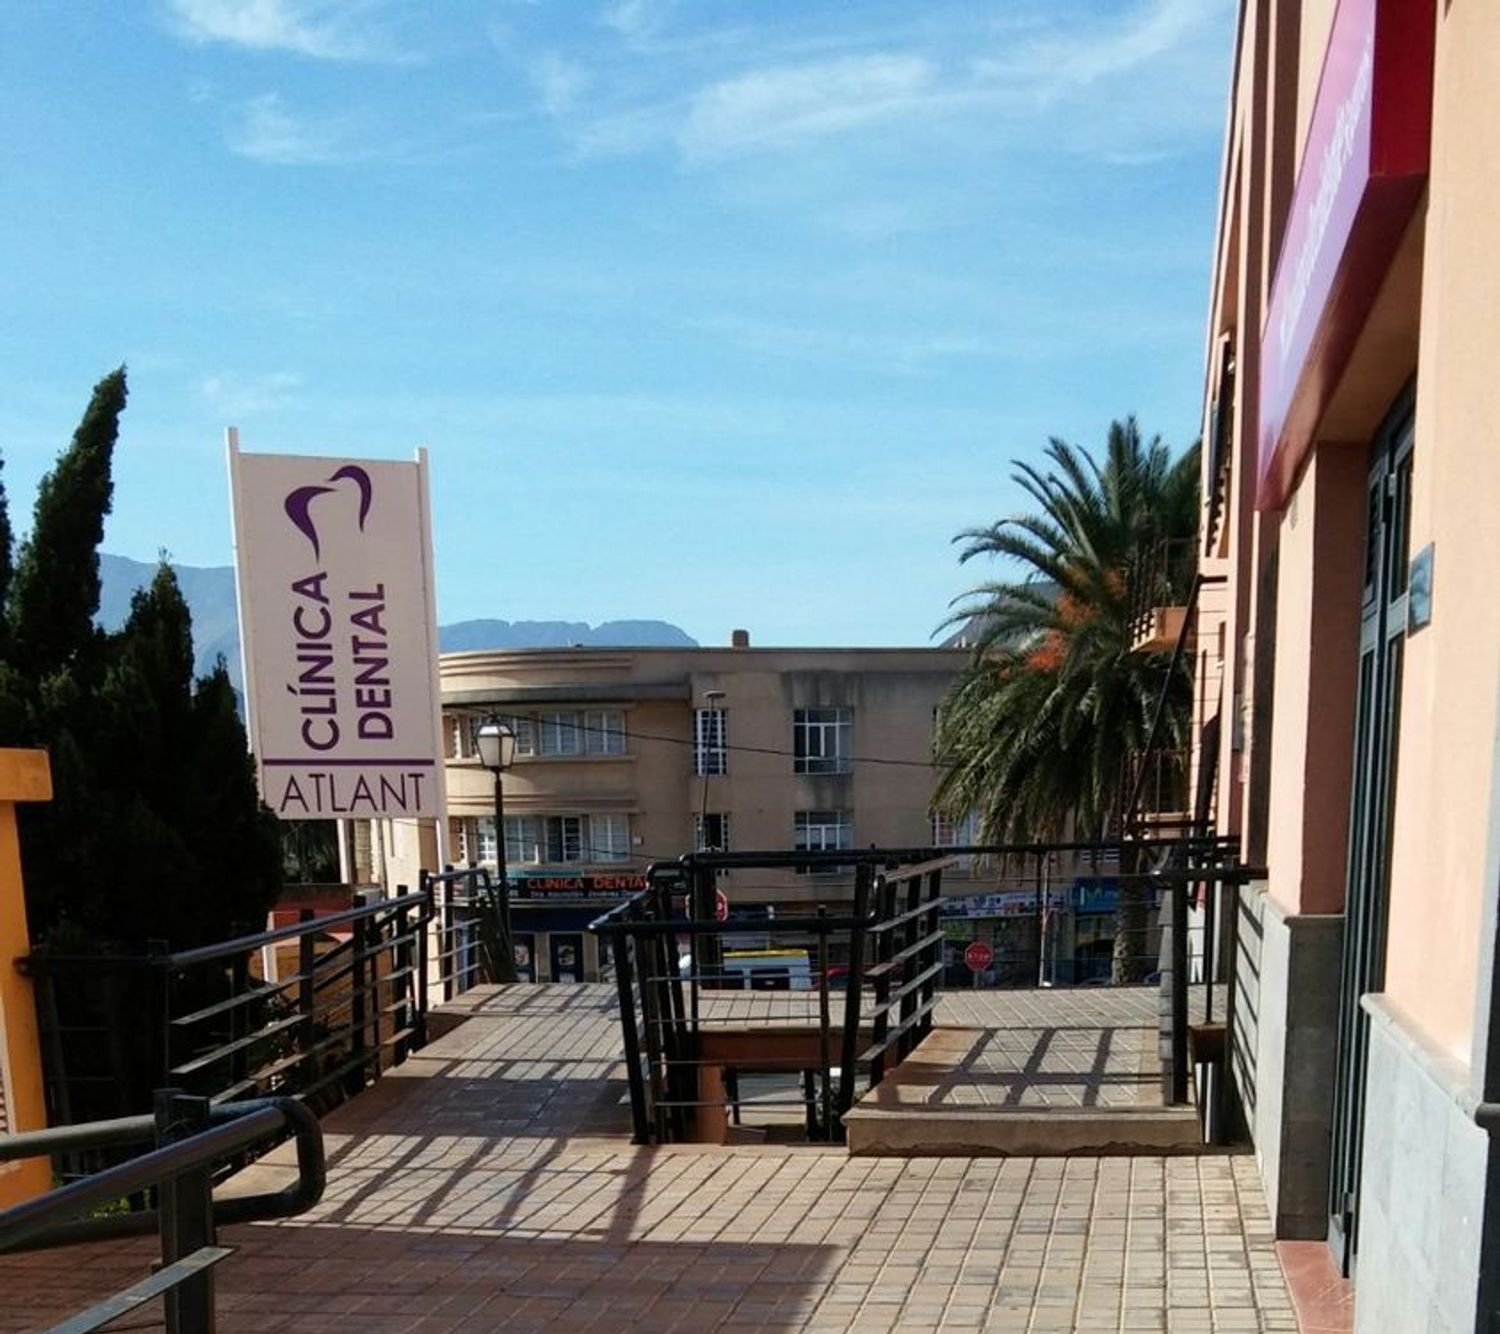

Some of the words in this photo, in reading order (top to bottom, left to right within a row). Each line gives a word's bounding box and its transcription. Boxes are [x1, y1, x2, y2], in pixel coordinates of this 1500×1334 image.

[287, 571, 340, 751] CLÍNICA
[349, 583, 394, 740] DENTAL
[280, 773, 425, 813] ATLANT
[593, 876, 649, 889] DENTA
